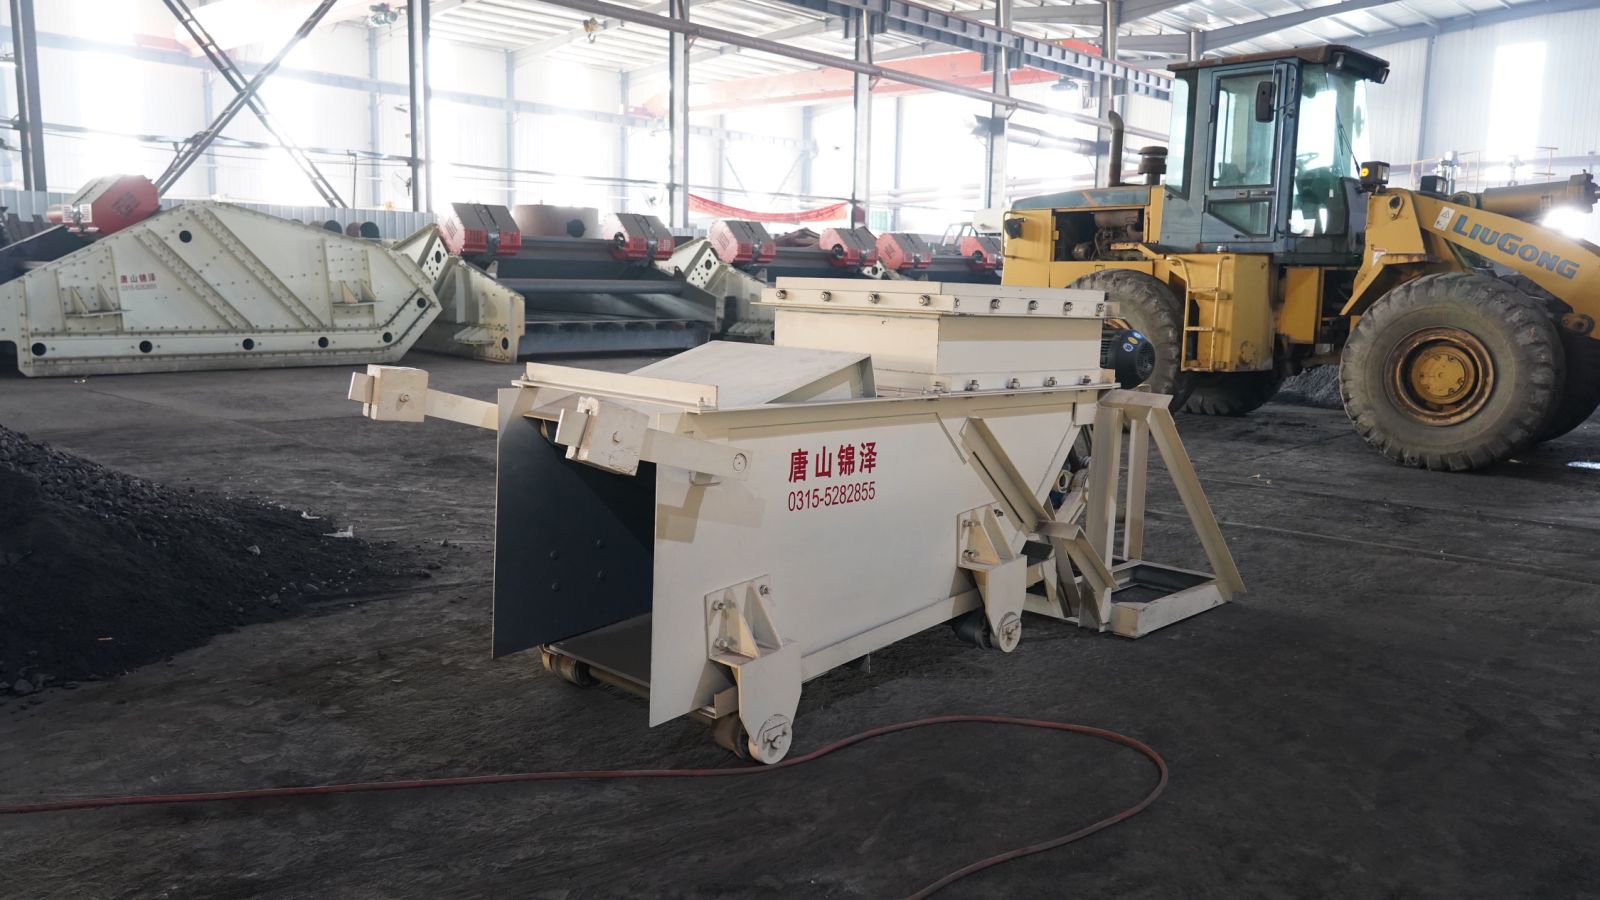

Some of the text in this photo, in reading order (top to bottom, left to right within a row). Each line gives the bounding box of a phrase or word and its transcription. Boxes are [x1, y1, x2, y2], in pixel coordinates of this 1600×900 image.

[788, 442, 877, 483] 唐山锦泽
[788, 481, 876, 511] 0315-5282855
